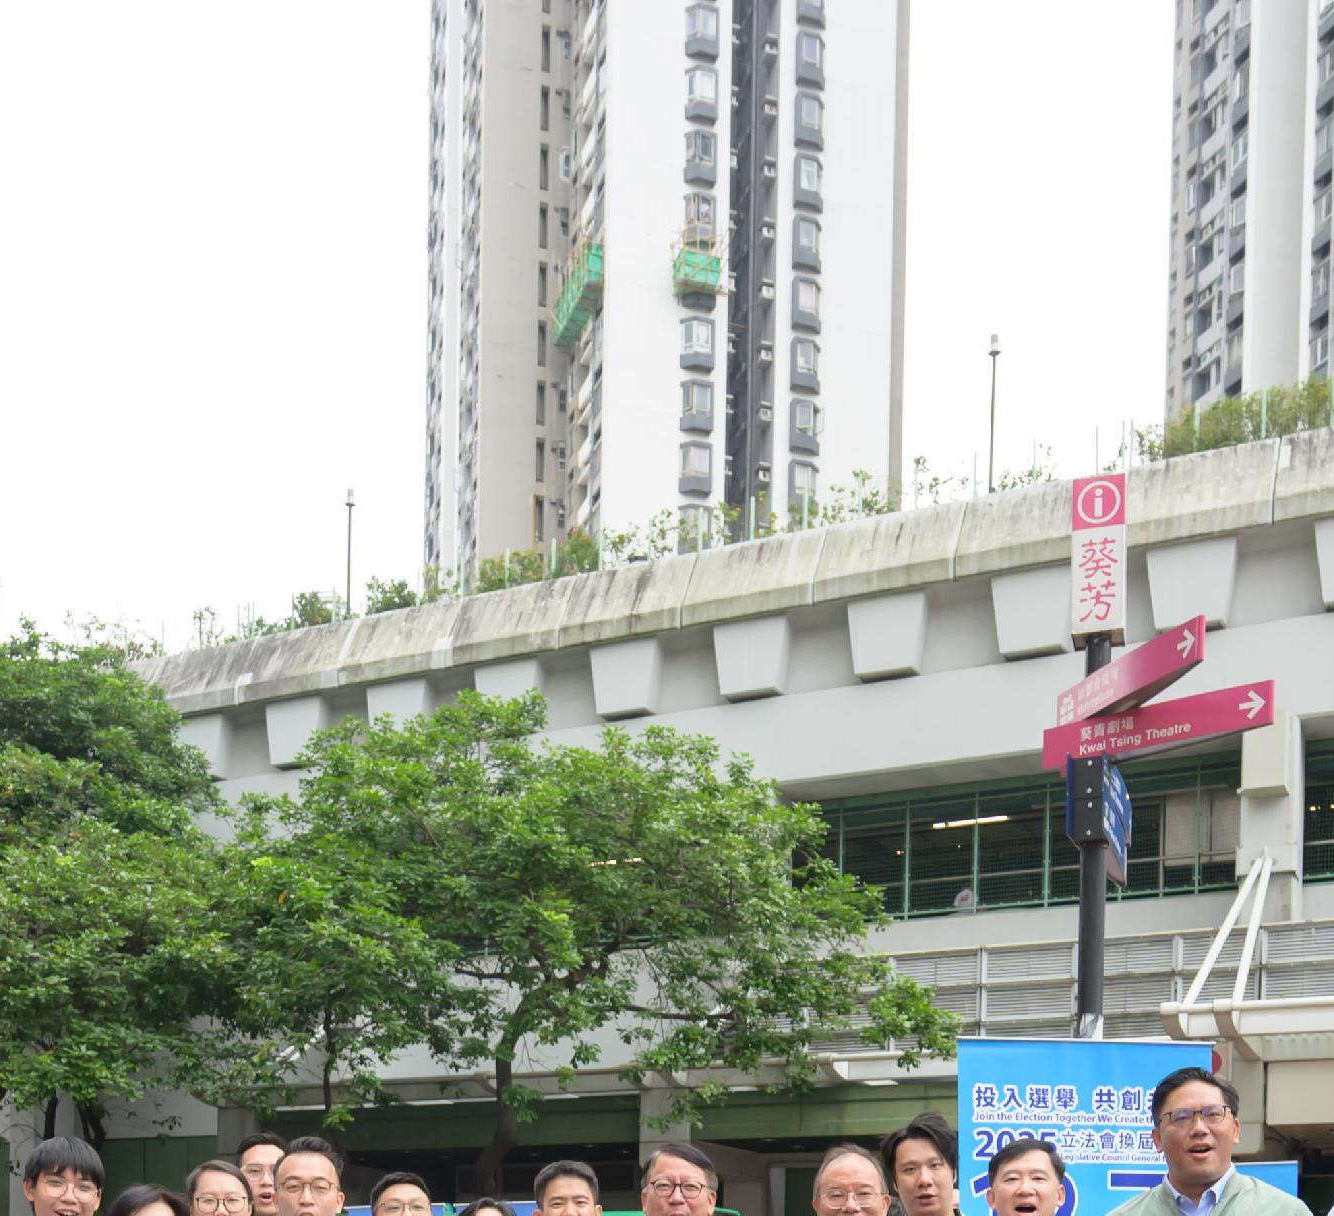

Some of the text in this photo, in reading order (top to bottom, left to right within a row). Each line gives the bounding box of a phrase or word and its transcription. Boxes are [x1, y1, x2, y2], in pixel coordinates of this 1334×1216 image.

[1078, 537, 1118, 622] 葵芳
[1079, 723, 1192, 756] Kwai Tsing Theatre
[1080, 716, 1134, 742] 葵青劇場
[975, 1086, 1076, 1109] 投入選舉
[975, 1112, 995, 1122] Join
[997, 1112, 1011, 1121] the
[1015, 1112, 1054, 1122] Election
[1055, 1114, 1095, 1124] Together
[1098, 1115, 1112, 1123] We
[1115, 1116, 1144, 1124] Create
[1061, 1132, 1154, 1150] 立法會換屆
